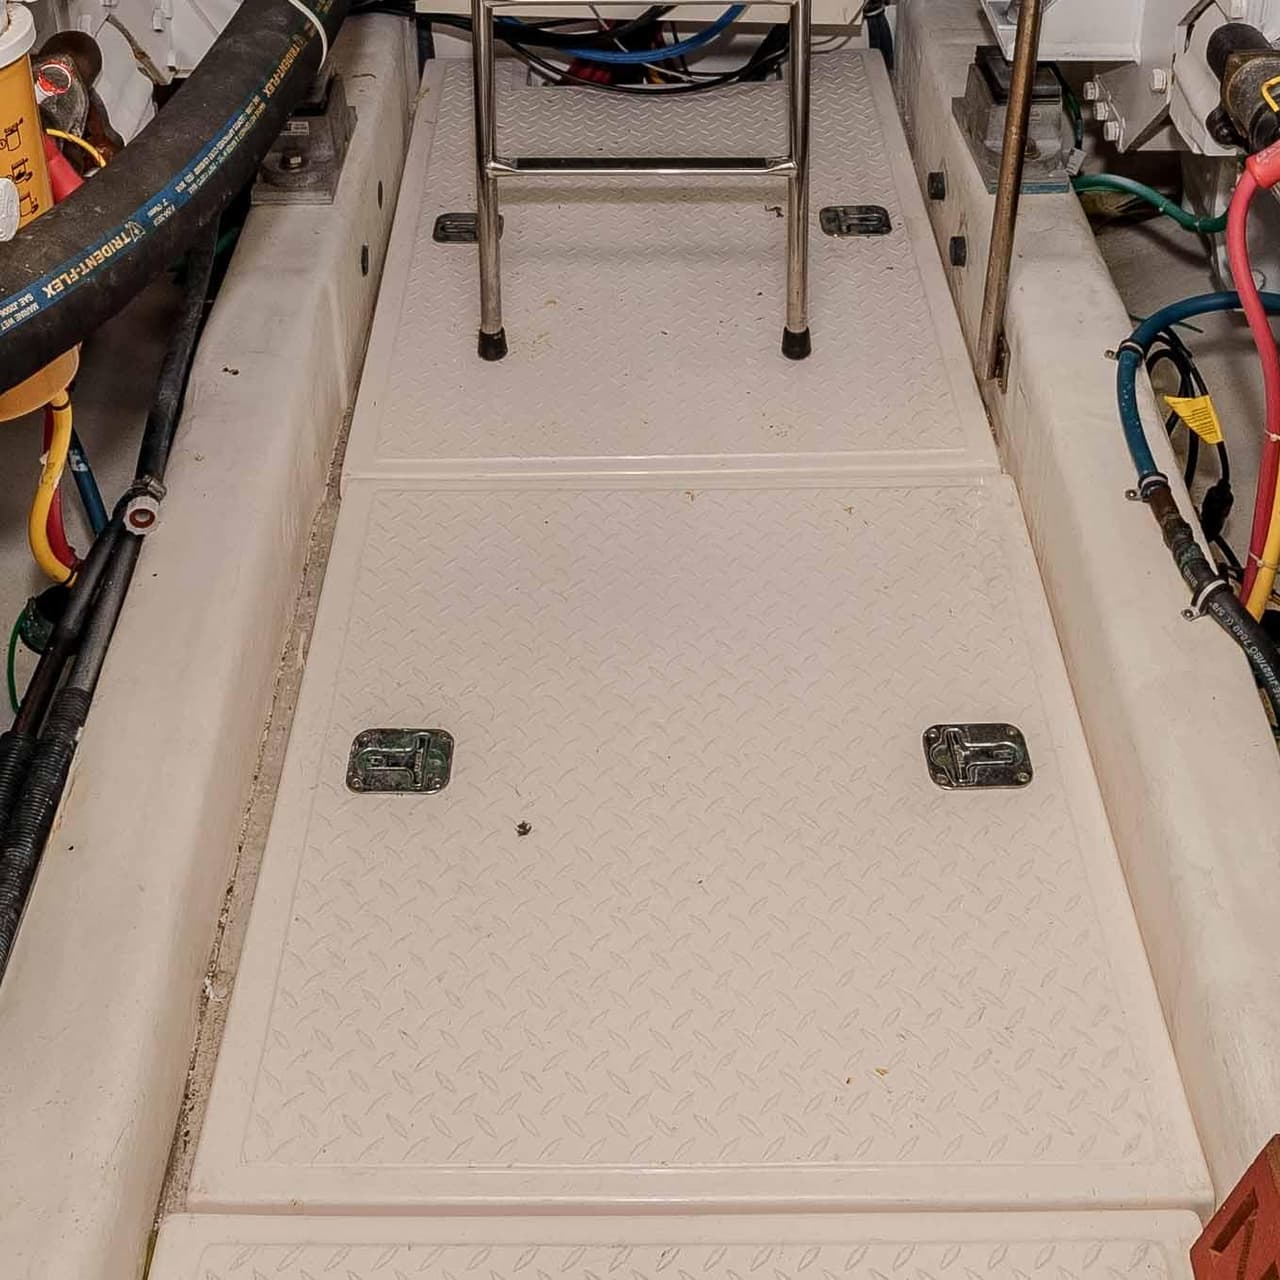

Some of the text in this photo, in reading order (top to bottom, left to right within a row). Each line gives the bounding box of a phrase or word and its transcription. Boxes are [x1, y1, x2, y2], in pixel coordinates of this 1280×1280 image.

[263, 42, 302, 99] TRIDENT-FLEX
[41, 230, 132, 299] TRIDENT-FLEX
[19, 294, 32, 304] SAE
[14, 303, 37, 319] MARINE
[0, 317, 14, 328] WET
